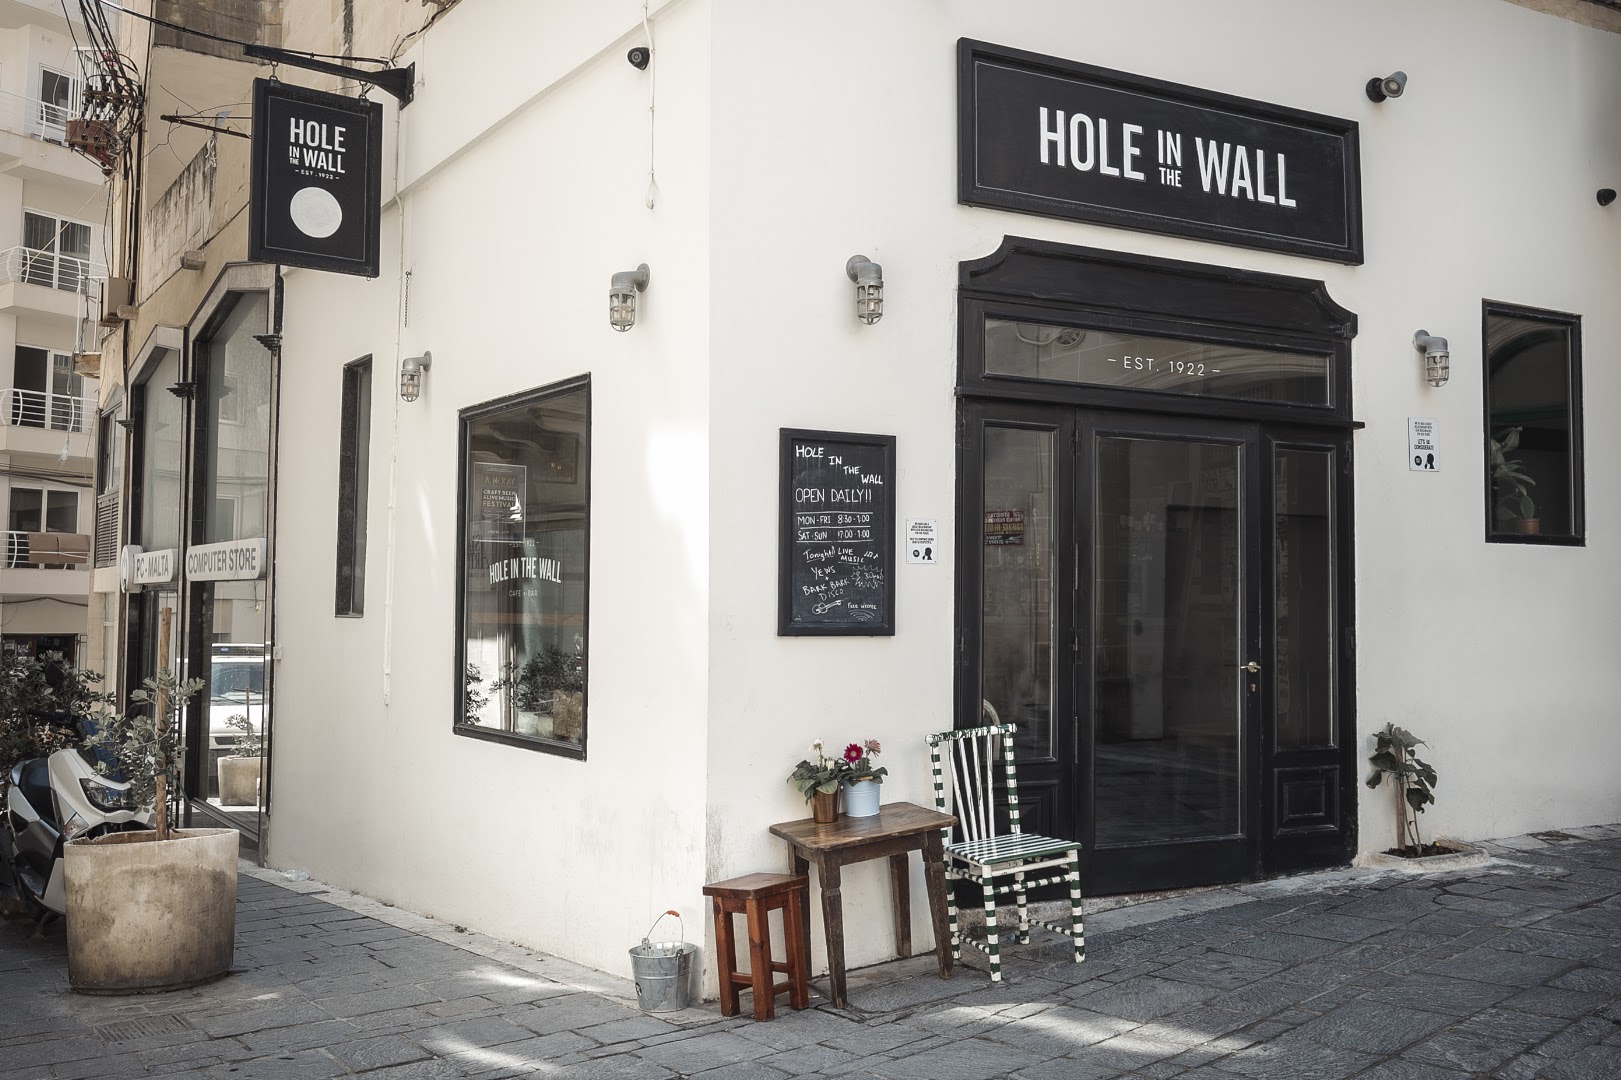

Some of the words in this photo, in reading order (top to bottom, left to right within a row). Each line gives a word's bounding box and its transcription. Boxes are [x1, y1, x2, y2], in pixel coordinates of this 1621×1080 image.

[290, 117, 346, 153] HOLE
[1039, 106, 1145, 181] HOLE
[1157, 129, 1182, 167] IN
[289, 145, 299, 158] IN
[303, 147, 346, 174] WALL
[289, 157, 299, 165] THE
[318, 172, 334, 180] 1922
[1159, 167, 1182, 188] THE
[1195, 136, 1297, 208] WALL
[1123, 355, 1160, 373] EST.
[1168, 360, 1206, 377] 1922
[795, 445, 825, 458] HOLE
[828, 456, 843, 465] IN
[843, 465, 862, 475] THE
[861, 474, 883, 485] WALL
[795, 488, 825, 503] OPEN
[831, 488, 872, 503] DAILY!!
[838, 547, 854, 556] LIVE
[840, 555, 864, 563] MUSIC
[188, 550, 227, 574] COMPUTER
[228, 547, 257, 571] STORE
[489, 560, 509, 585] HOLE
[510, 557, 519, 579] IN
[520, 557, 537, 578] THE
[539, 557, 562, 584] WALL
[508, 589, 522, 597] CAFE
[527, 589, 538, 597] BAR
[802, 583, 828, 596] BARK
[829, 577, 850, 590] BARK
[818, 589, 844, 601] DISCO
